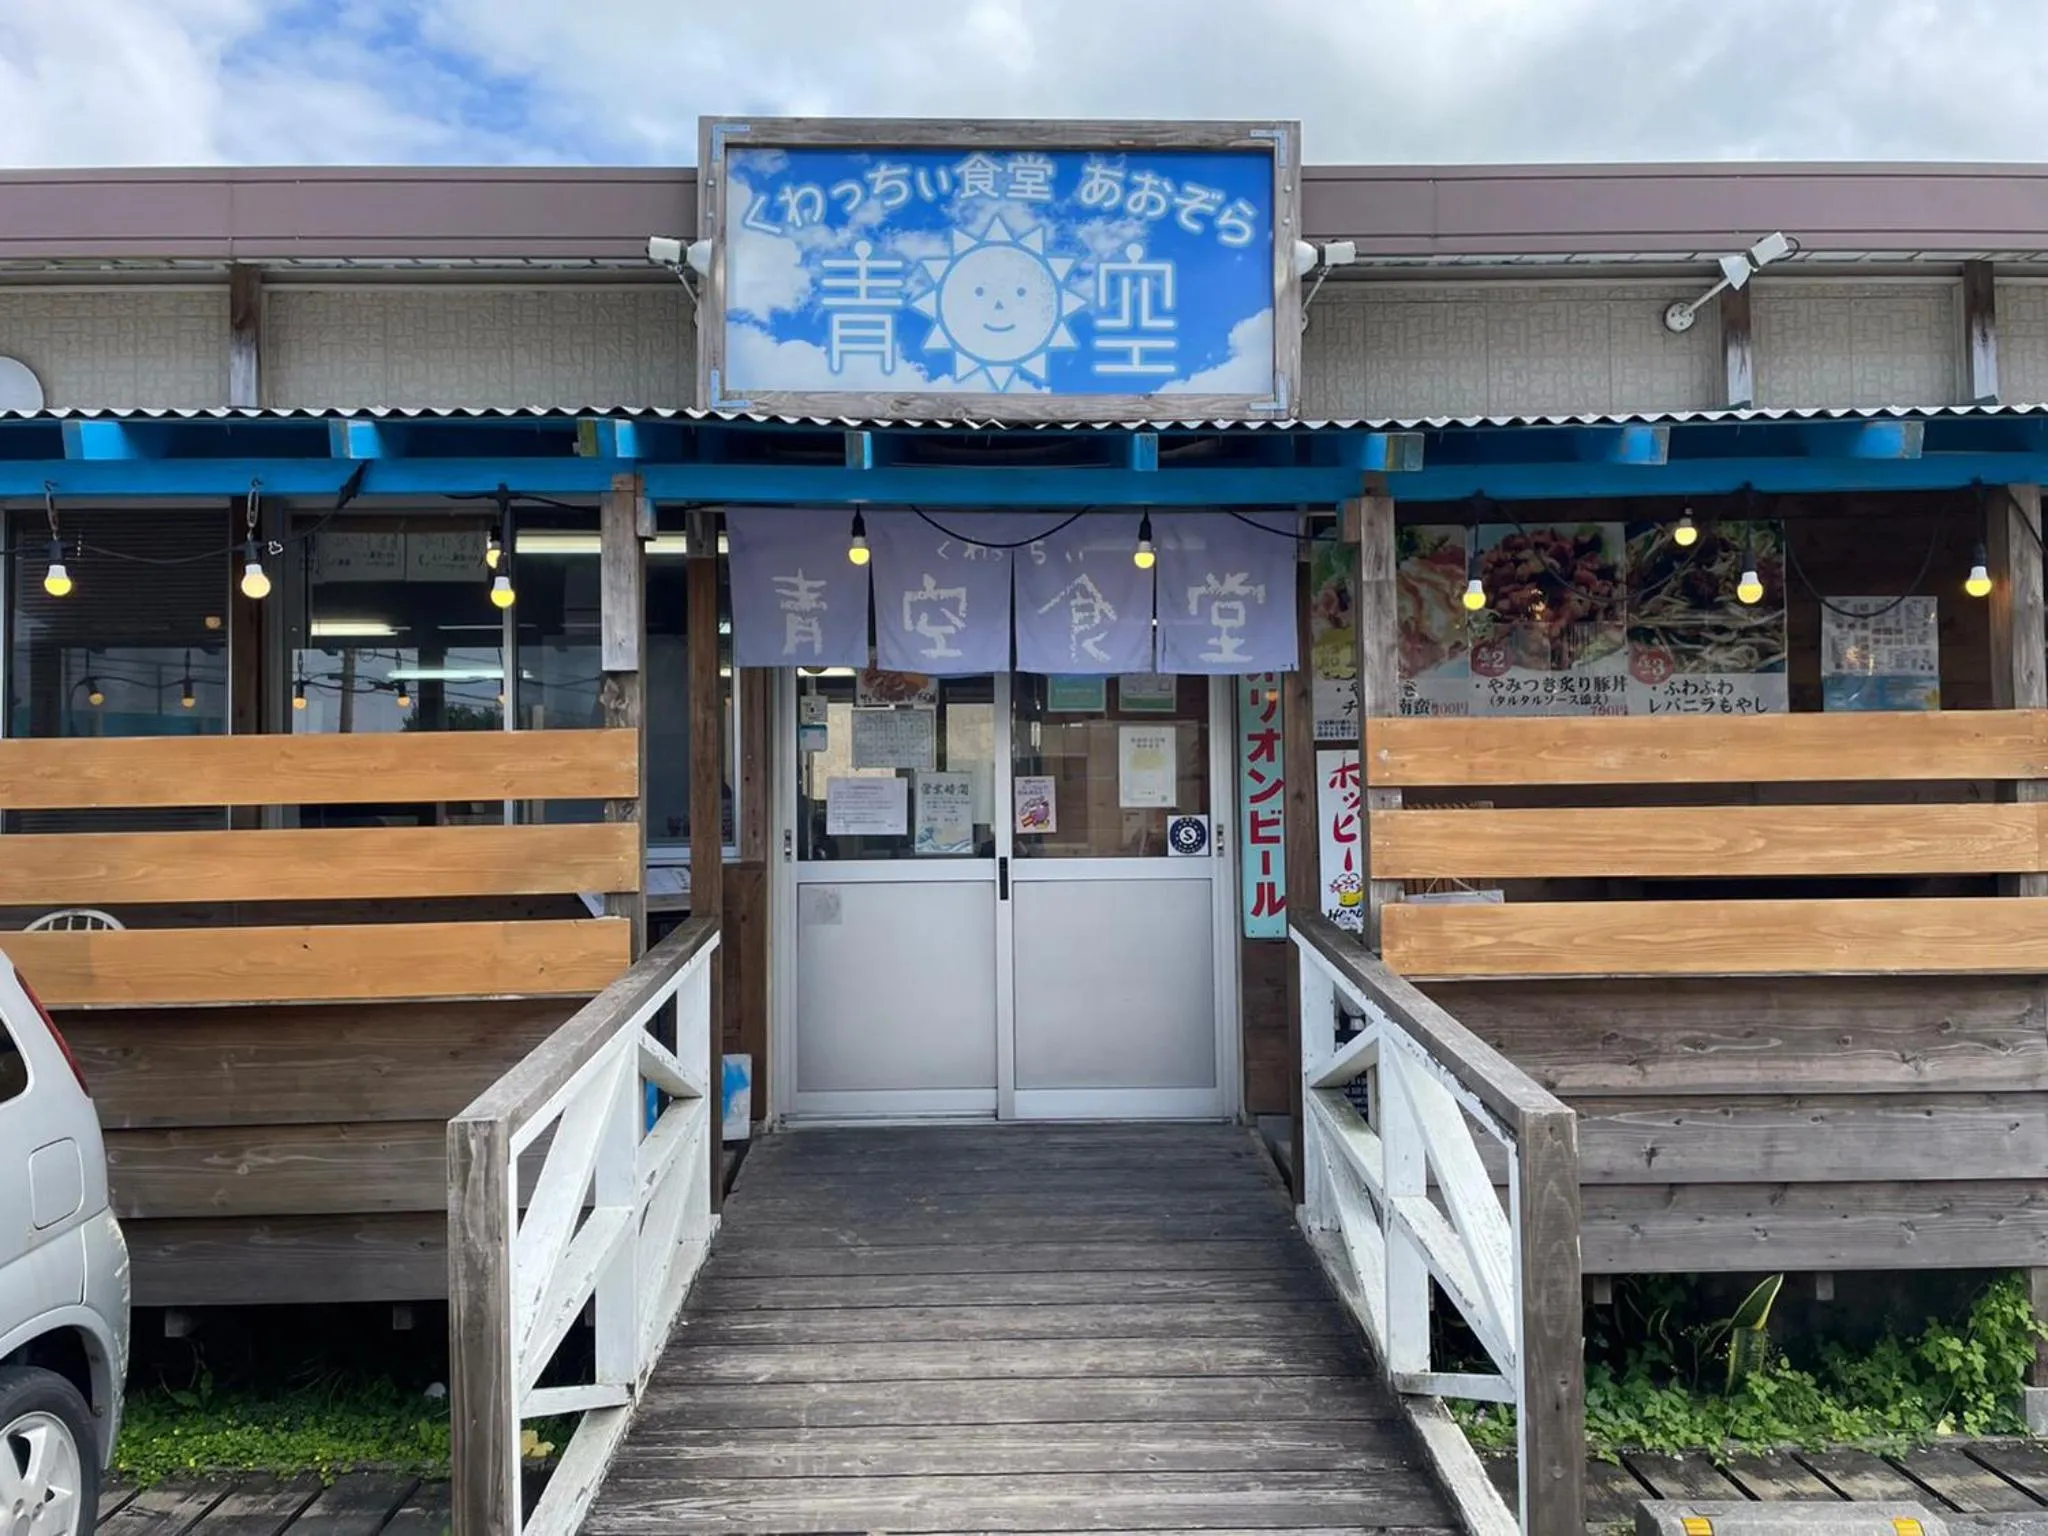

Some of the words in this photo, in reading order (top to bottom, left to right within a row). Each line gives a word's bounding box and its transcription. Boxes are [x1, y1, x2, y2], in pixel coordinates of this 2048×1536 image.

[1081, 163, 1256, 246] あおぞら
[1649, 696, 1769, 714] レバニラもやし
[1664, 679, 1734, 696] ふわふわ
[1246, 673, 1287, 918] リオンビール
